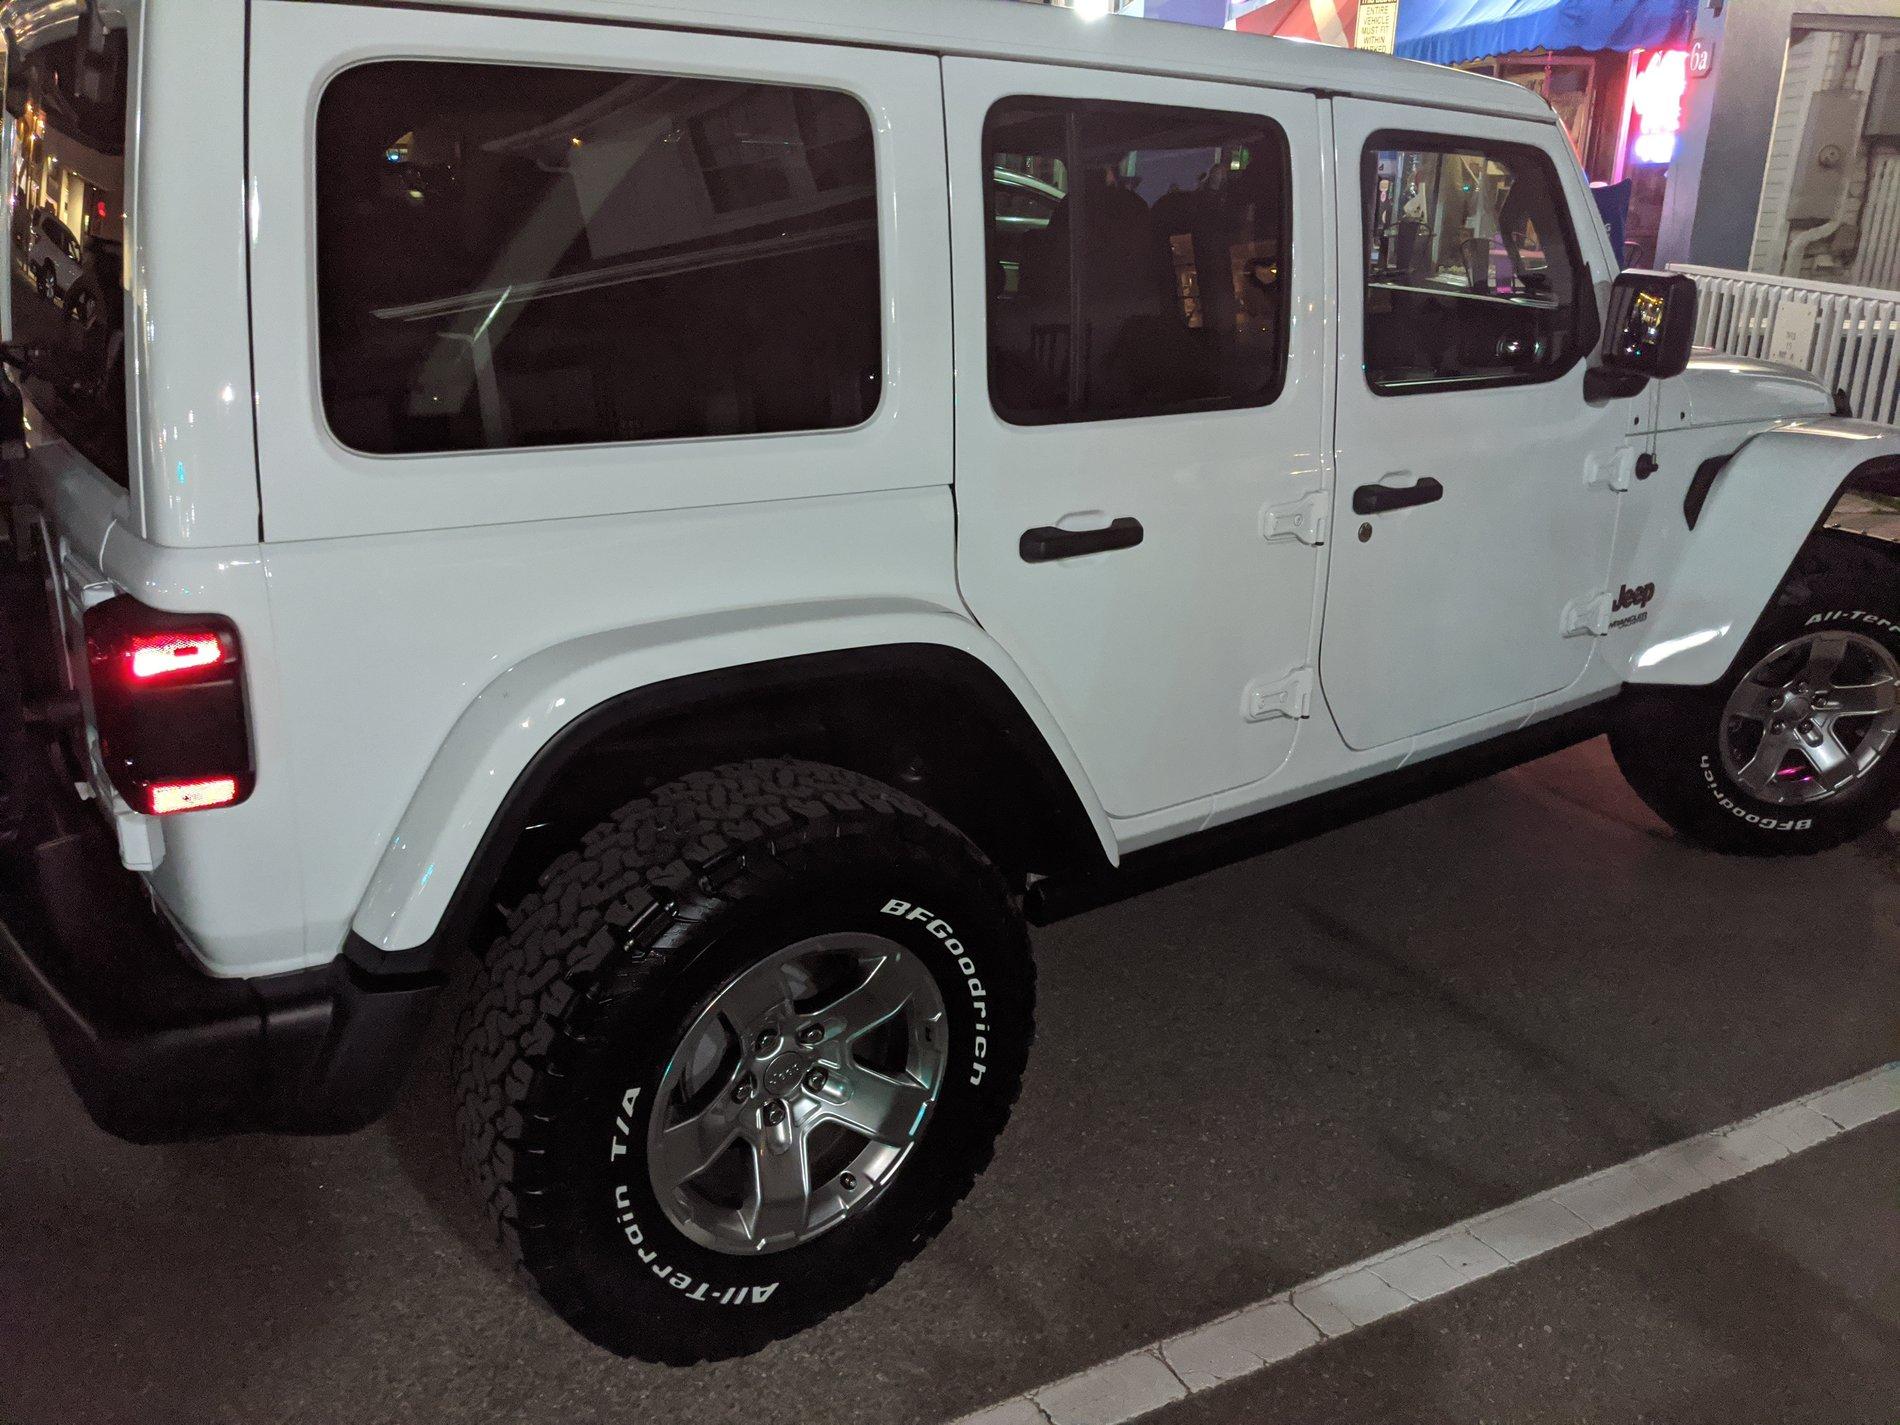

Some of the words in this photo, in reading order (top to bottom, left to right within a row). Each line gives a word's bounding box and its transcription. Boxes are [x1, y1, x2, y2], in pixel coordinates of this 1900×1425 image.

[1364, 15, 1390, 25] VEHICLE
[1366, 5, 1389, 15] ENTIRE
[1361, 26, 1379, 35] MUST
[1380, 25, 1390, 33] FIT
[1363, 35, 1386, 44] WITHIN
[1690, 42, 1708, 71] 6a
[1611, 581, 1656, 612] Jeep
[1699, 754, 1813, 831] BFGoodrich
[879, 898, 991, 1087] BFGoodrich
[610, 1086, 641, 1162] T/A
[614, 1184, 780, 1305] All-Terrain
